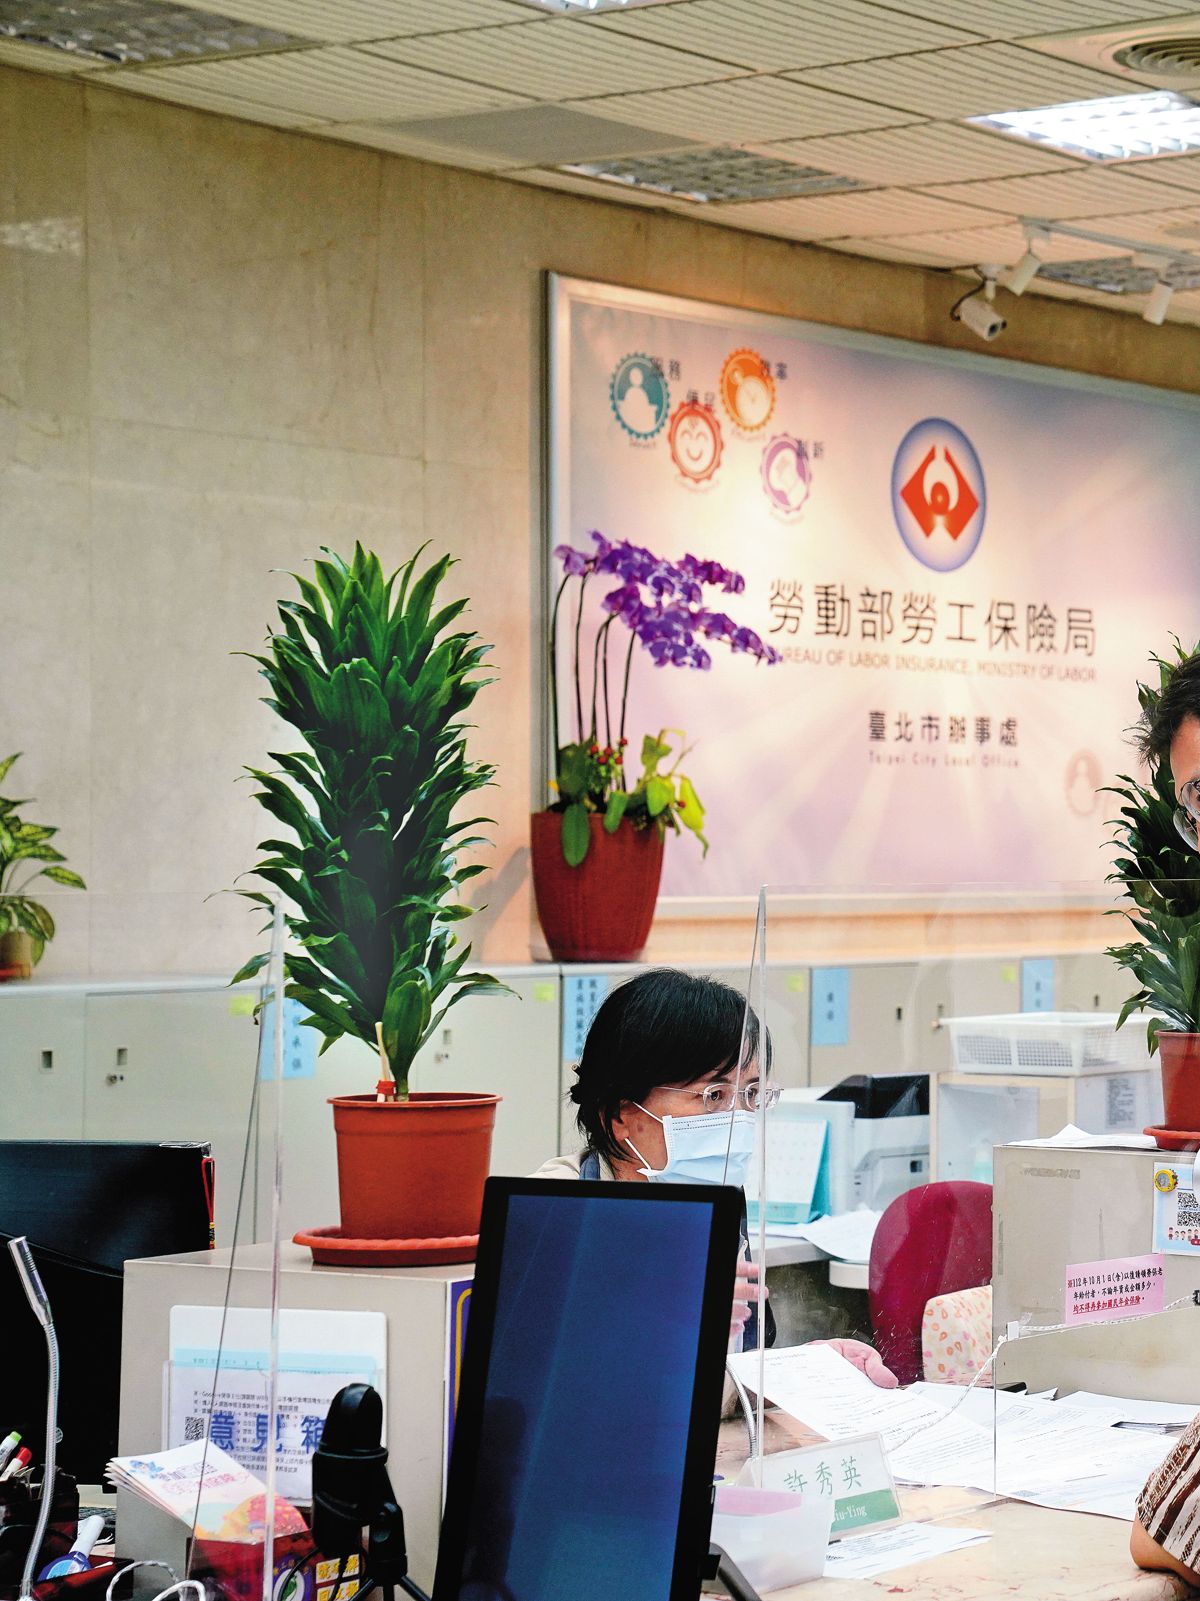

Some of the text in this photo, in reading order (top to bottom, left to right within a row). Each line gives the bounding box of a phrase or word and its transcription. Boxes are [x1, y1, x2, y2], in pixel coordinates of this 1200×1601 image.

[769, 579, 1096, 658] 勞動部勞工保險局
[848, 650, 889, 670] LABOR
[868, 710, 1018, 747] 臺北市辦事處
[209, 1411, 328, 1455] 意見箱
[783, 1455, 862, 1496] 許秀英
[834, 1504, 868, 1521] iu-Ying
